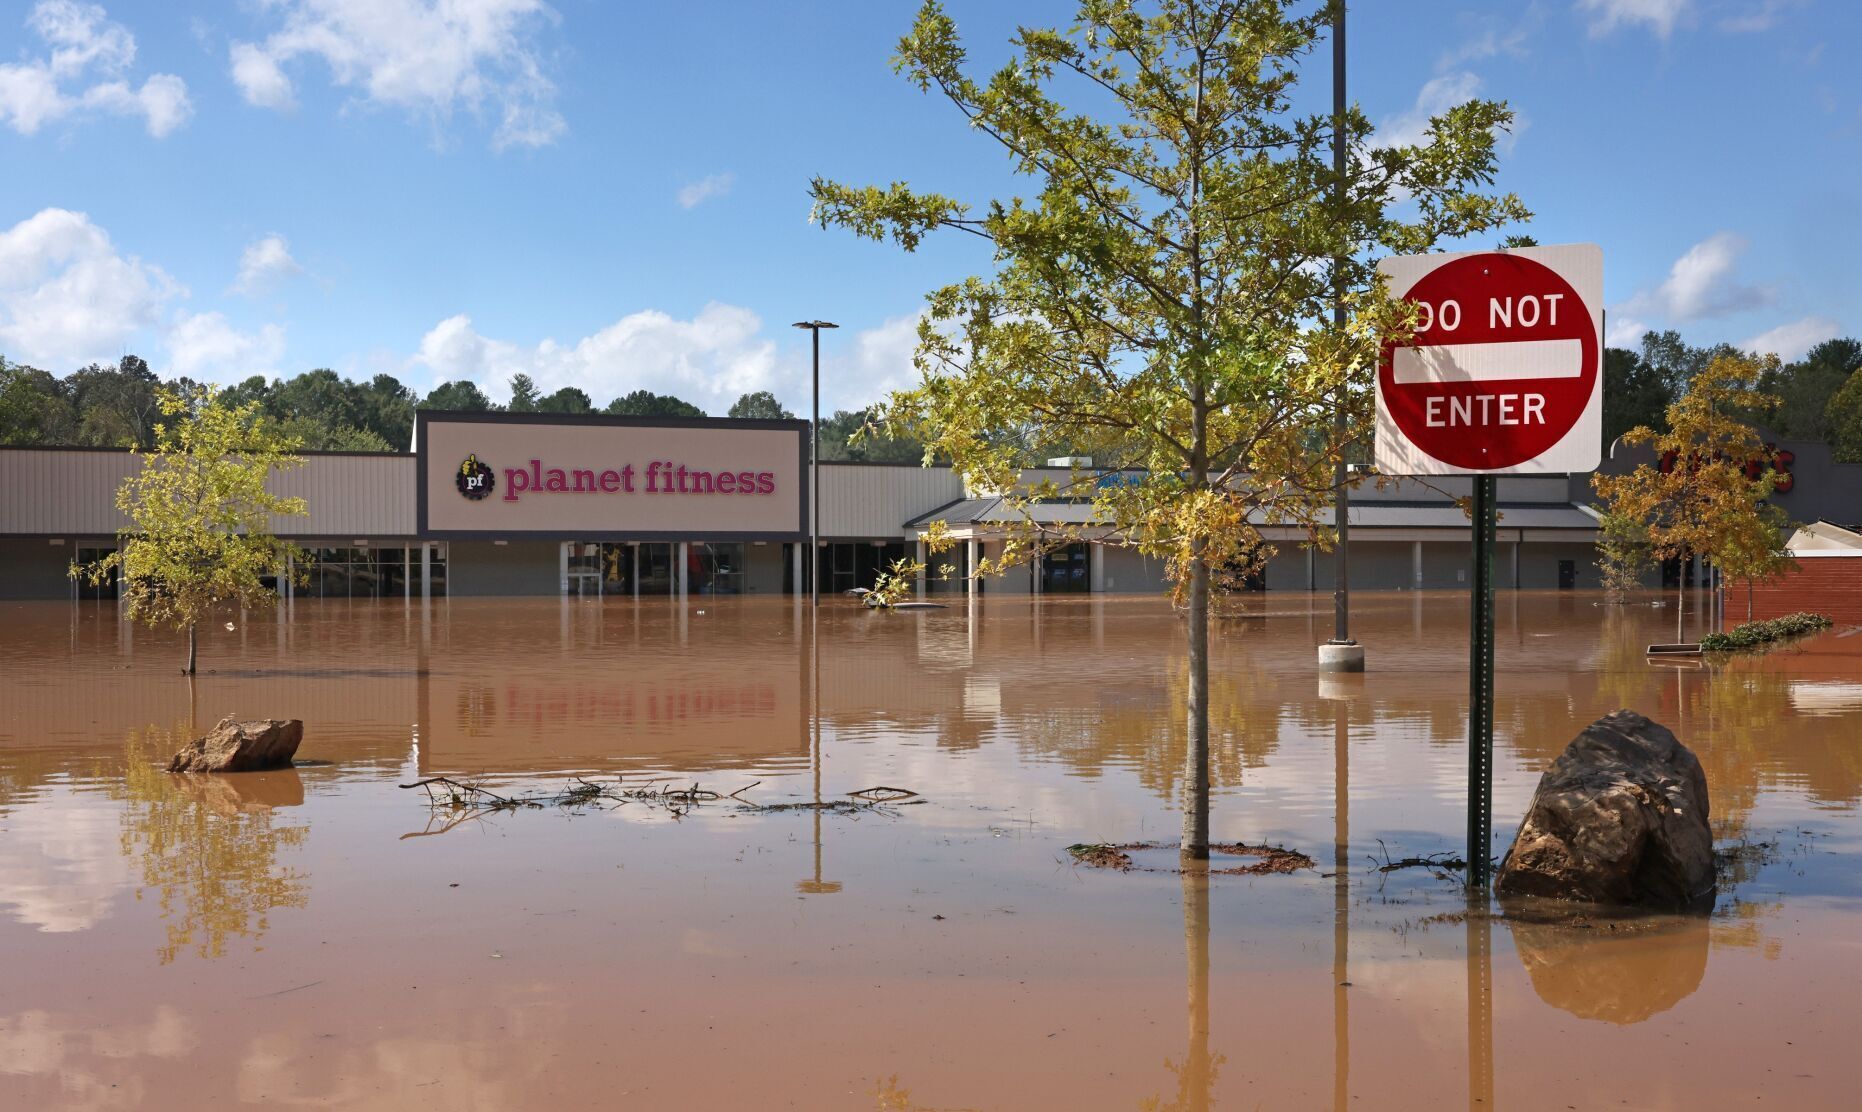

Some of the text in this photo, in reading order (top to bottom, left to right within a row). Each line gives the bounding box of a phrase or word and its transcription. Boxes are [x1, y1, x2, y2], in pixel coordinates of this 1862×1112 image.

[1412, 294, 1564, 332] DO NOT
[1426, 393, 1546, 427] ENTER
[467, 474, 484, 489] pf
[504, 459, 775, 501] planet fitness
